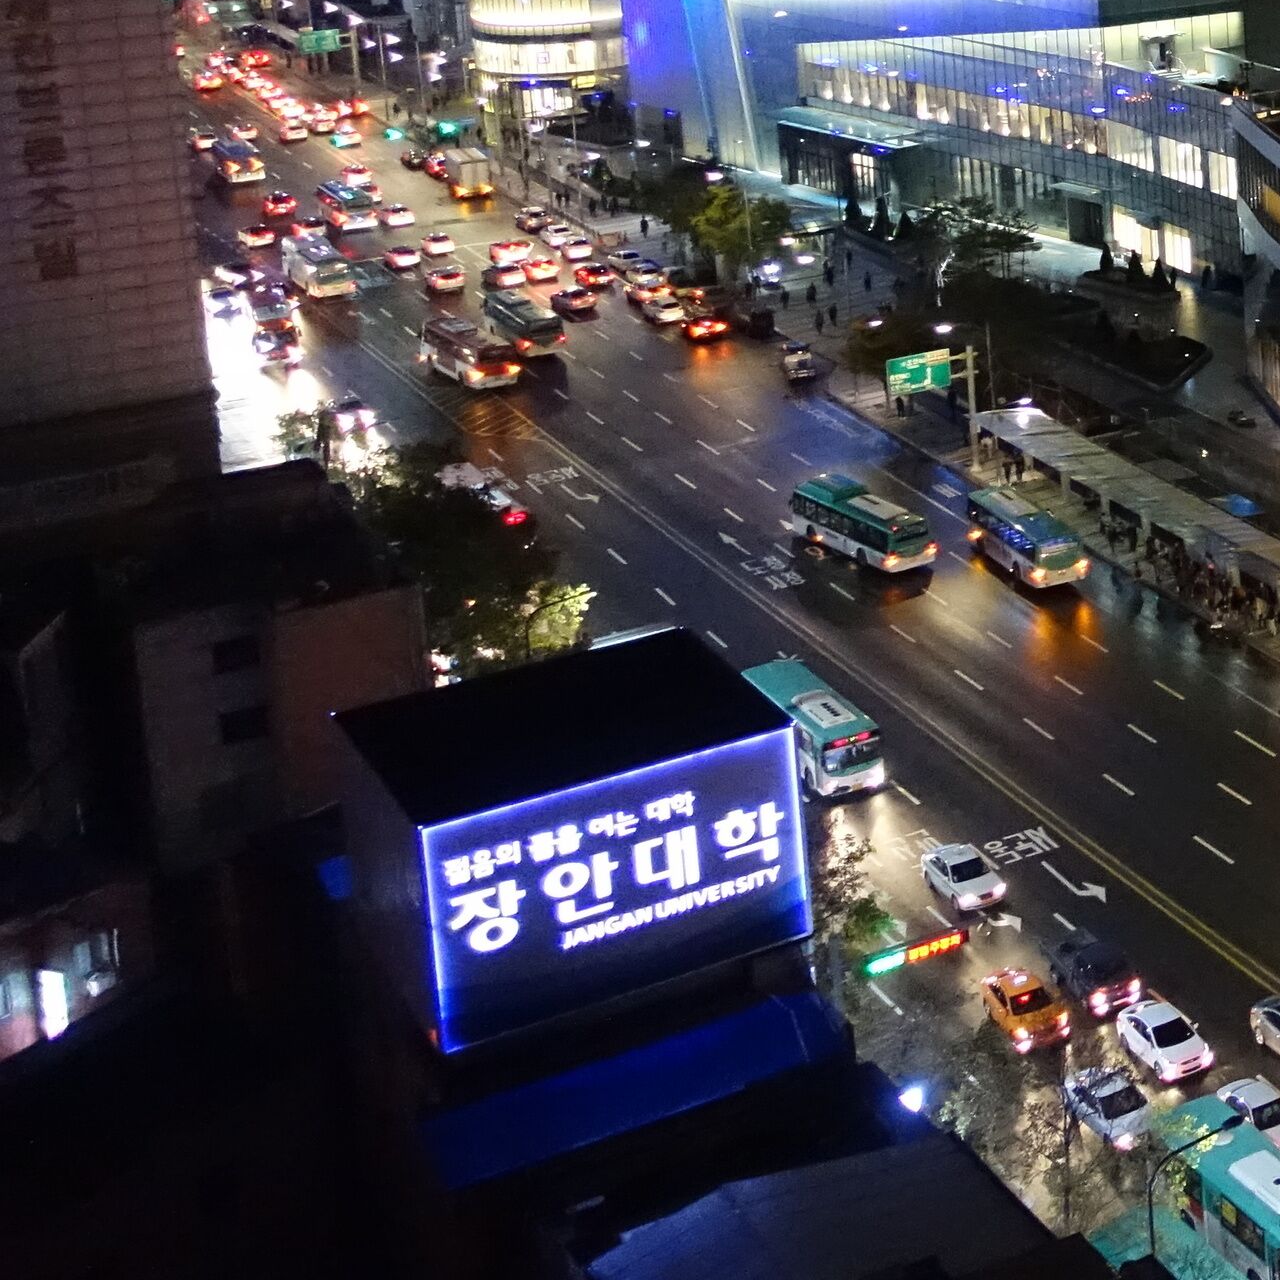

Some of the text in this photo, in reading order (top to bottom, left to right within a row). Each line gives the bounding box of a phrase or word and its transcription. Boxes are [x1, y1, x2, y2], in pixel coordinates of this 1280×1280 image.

[443, 841, 522, 886] 젊음의
[588, 811, 640, 838] 여는
[645, 790, 696, 822] 대학
[447, 801, 786, 954] 장안대학
[983, 825, 1061, 865] 서둔동
[560, 864, 781, 951] JANGAN UNIVERSITY
